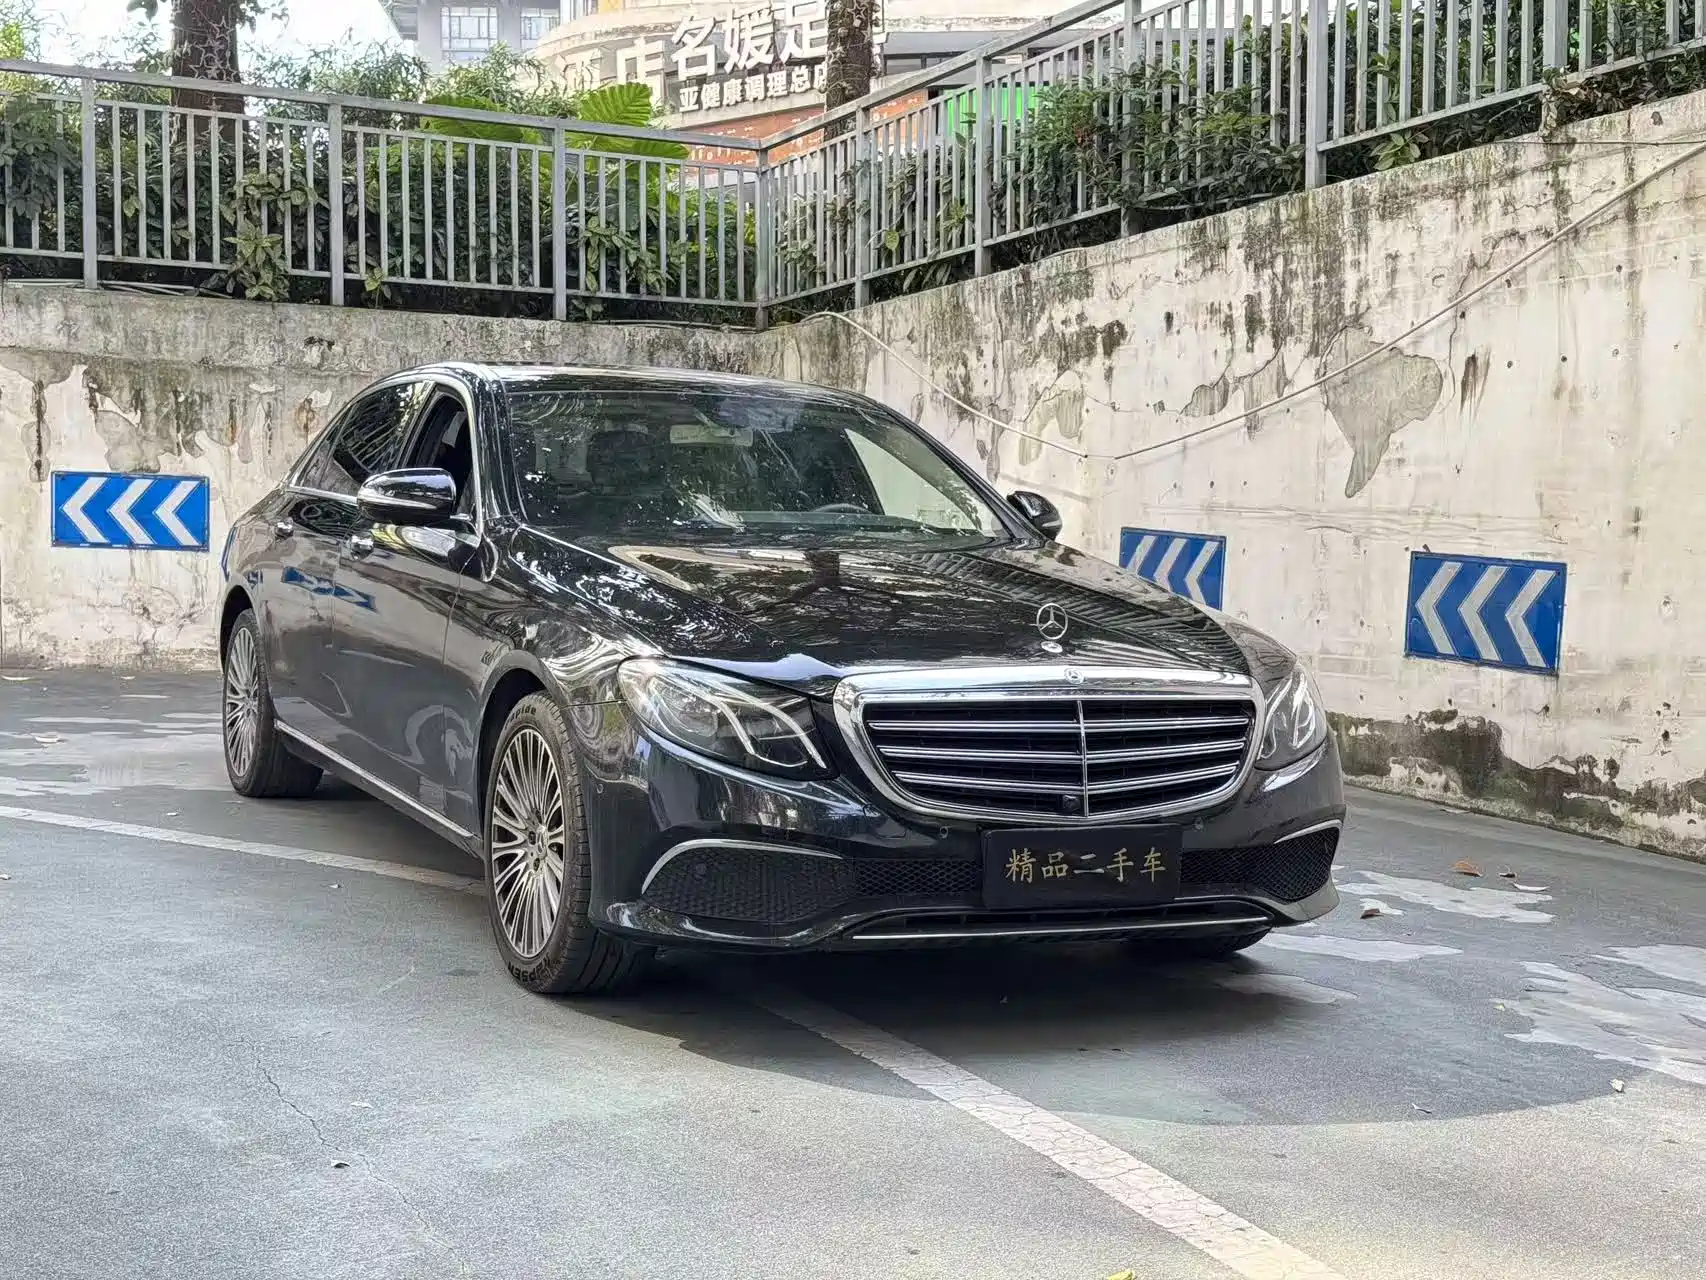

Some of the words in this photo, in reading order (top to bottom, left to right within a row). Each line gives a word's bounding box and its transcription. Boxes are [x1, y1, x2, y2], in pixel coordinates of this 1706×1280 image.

[670, 0, 888, 81] 名媛足
[1004, 846, 1167, 884] 精品二手车
